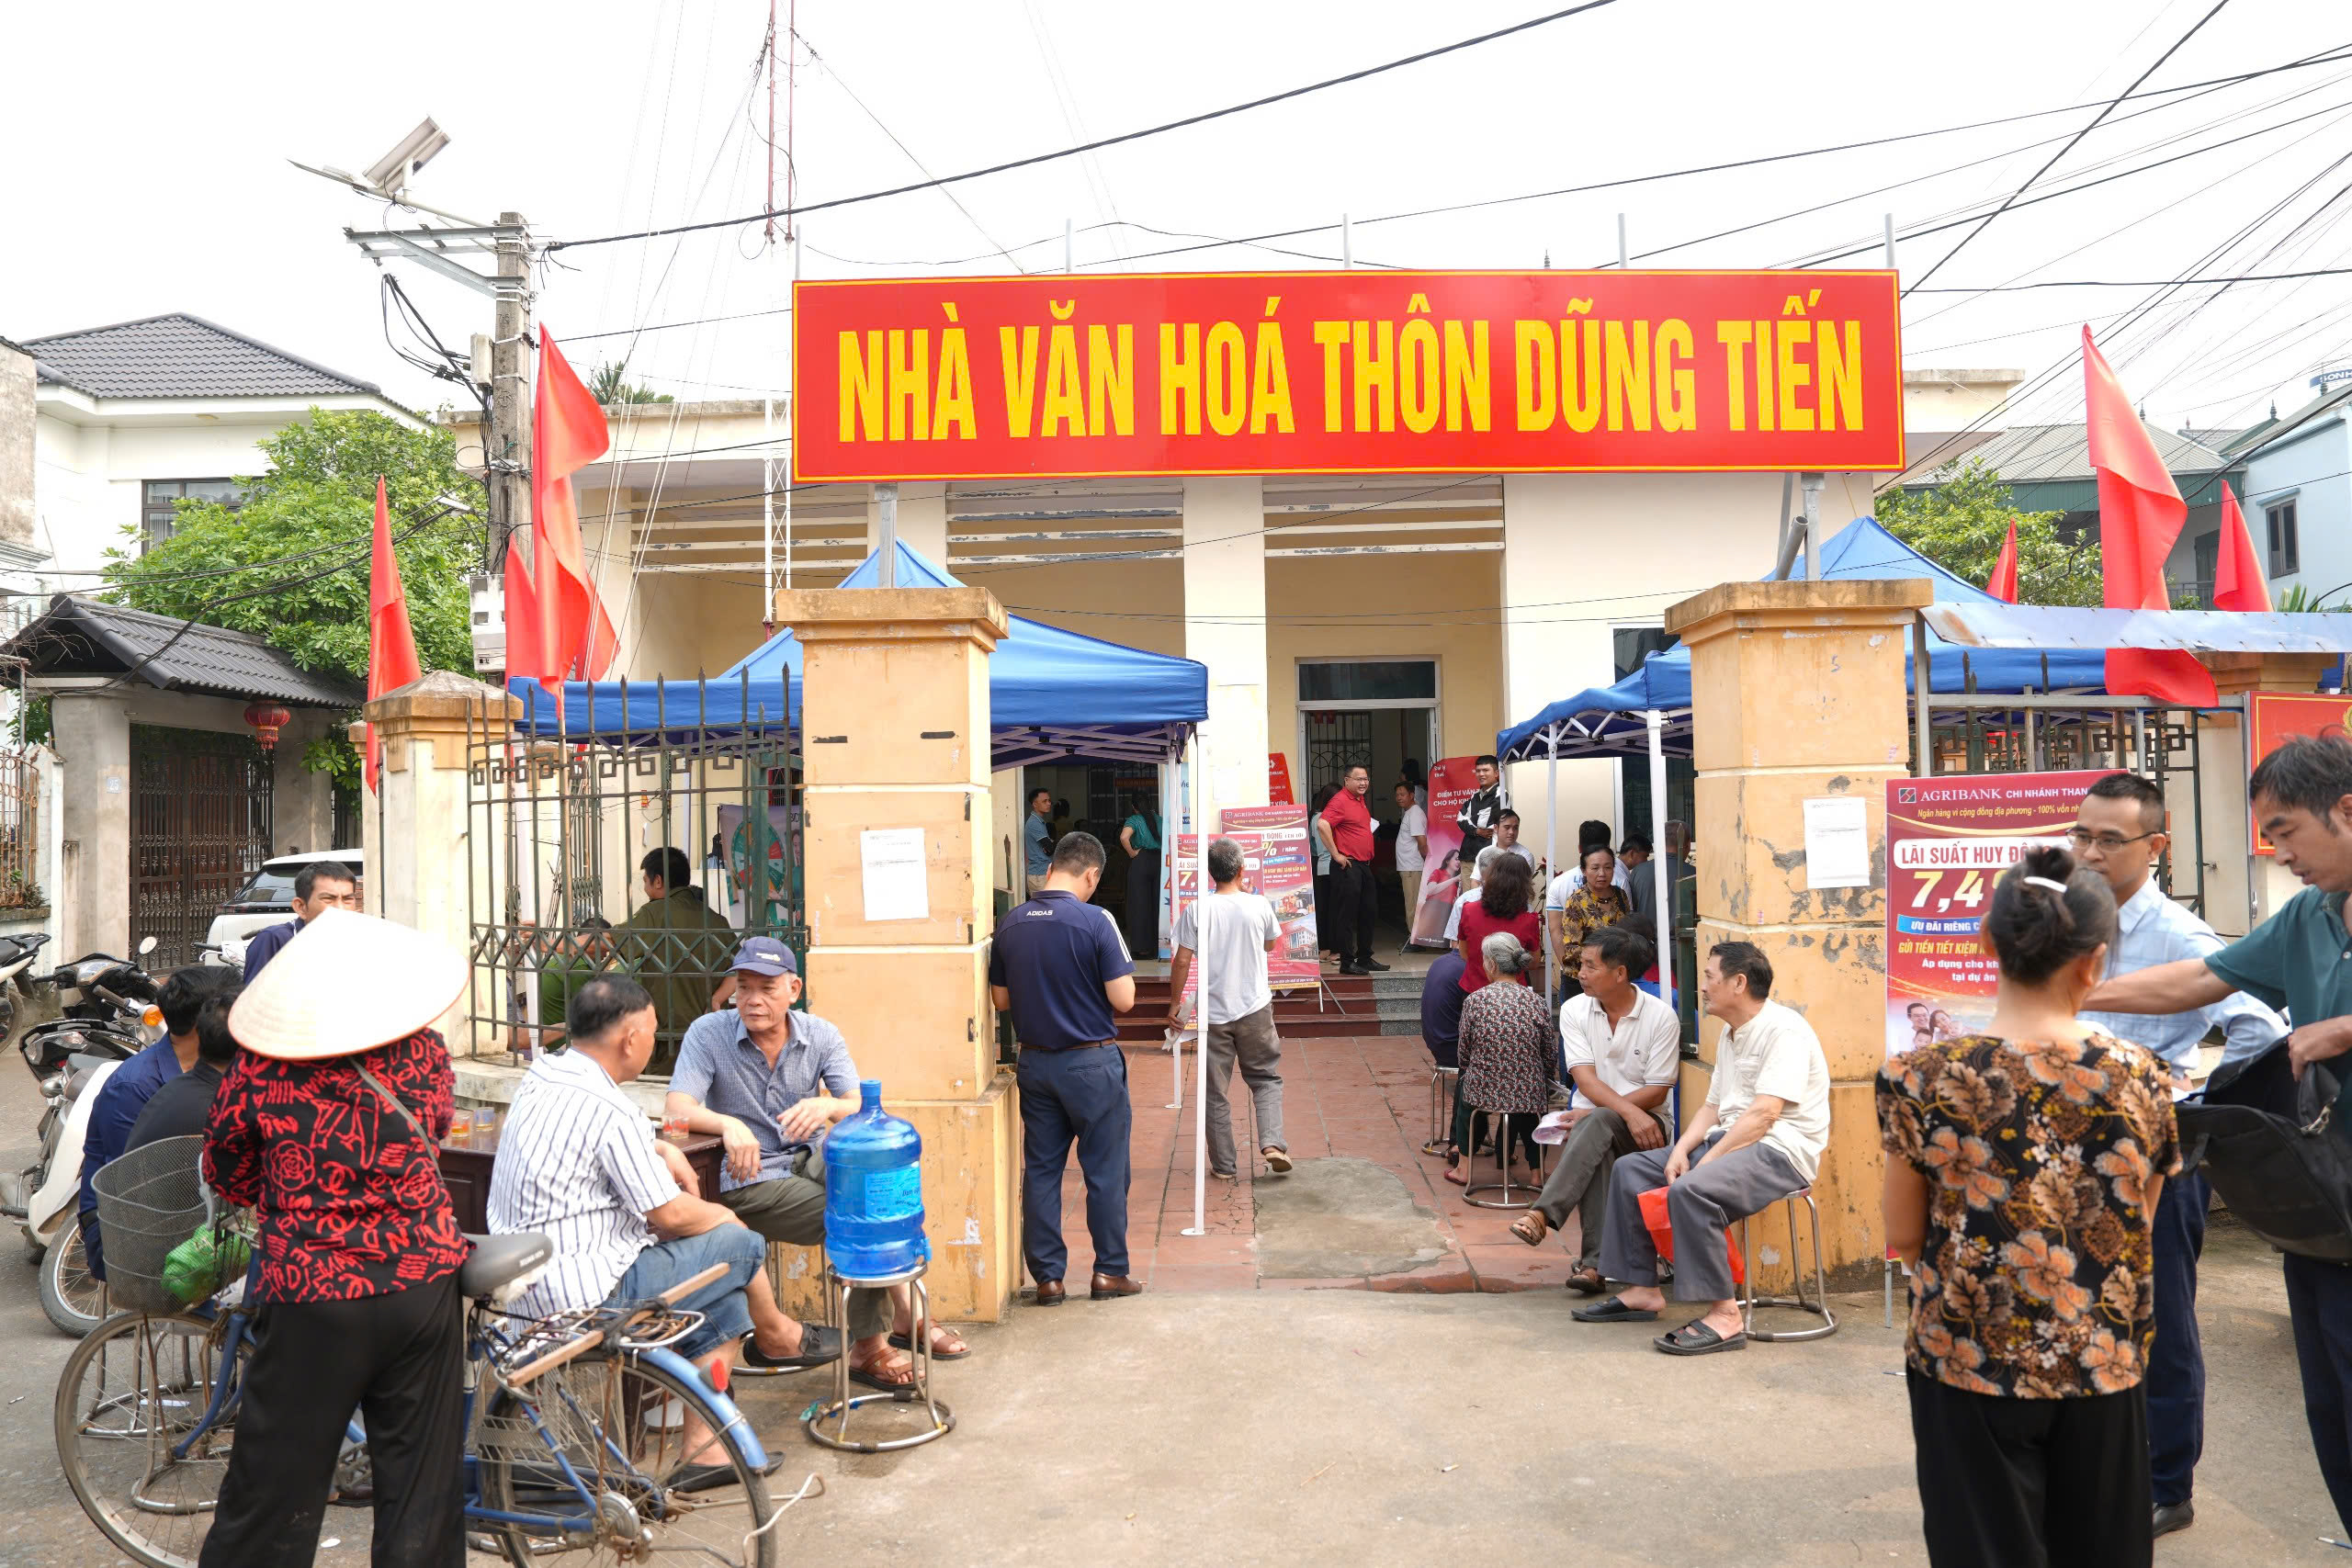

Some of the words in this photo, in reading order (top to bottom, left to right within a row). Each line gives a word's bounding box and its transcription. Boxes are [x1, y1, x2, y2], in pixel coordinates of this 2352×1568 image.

[840, 302, 977, 442] NHÀ
[1000, 300, 1134, 437] VĂN
[1160, 297, 1295, 435] HOÁ
[1315, 294, 1490, 433] THÔN
[1515, 298, 1696, 433] DŨNG
[1717, 289, 1863, 431] TIẾN
[1920, 788, 2002, 801] AGRIBANK
[2006, 790, 2022, 798] CHI
[2024, 787, 2058, 797] NHÁNH
[2061, 787, 2088, 796] THAN
[1917, 808, 1934, 819] Ngân
[1935, 808, 1951, 819] hàng
[1952, 808, 1959, 817] vì
[1960, 808, 1975, 818] cộng
[1977, 806, 1993, 818] đồng
[1995, 807, 2005, 817] địa
[2006, 807, 2032, 817] phương
[2038, 805, 2055, 814] 100%
[2071, 805, 2081, 813] nh
[1902, 844, 1925, 864] LÃI
[1929, 841, 1969, 864] SUẤT
[1973, 846, 2003, 863] HUY
[1911, 870, 2005, 913] 7,4
[1911, 920, 1925, 930] ƯU
[1926, 920, 1941, 931] ĐÃI
[1943, 920, 1972, 931] RIÊNG
[1898, 938, 1913, 953] GỬI
[1936, 940, 1954, 953] TIẾT
[1955, 941, 1978, 956] KIỆM
[1922, 958, 1936, 968] Áp
[1938, 959, 1962, 969] dụng
[1964, 960, 1984, 968] cho
[1986, 960, 1999, 968] kh
[1952, 973, 1965, 982] tại
[1968, 973, 1982, 983] dự
[1984, 972, 1996, 982] án
